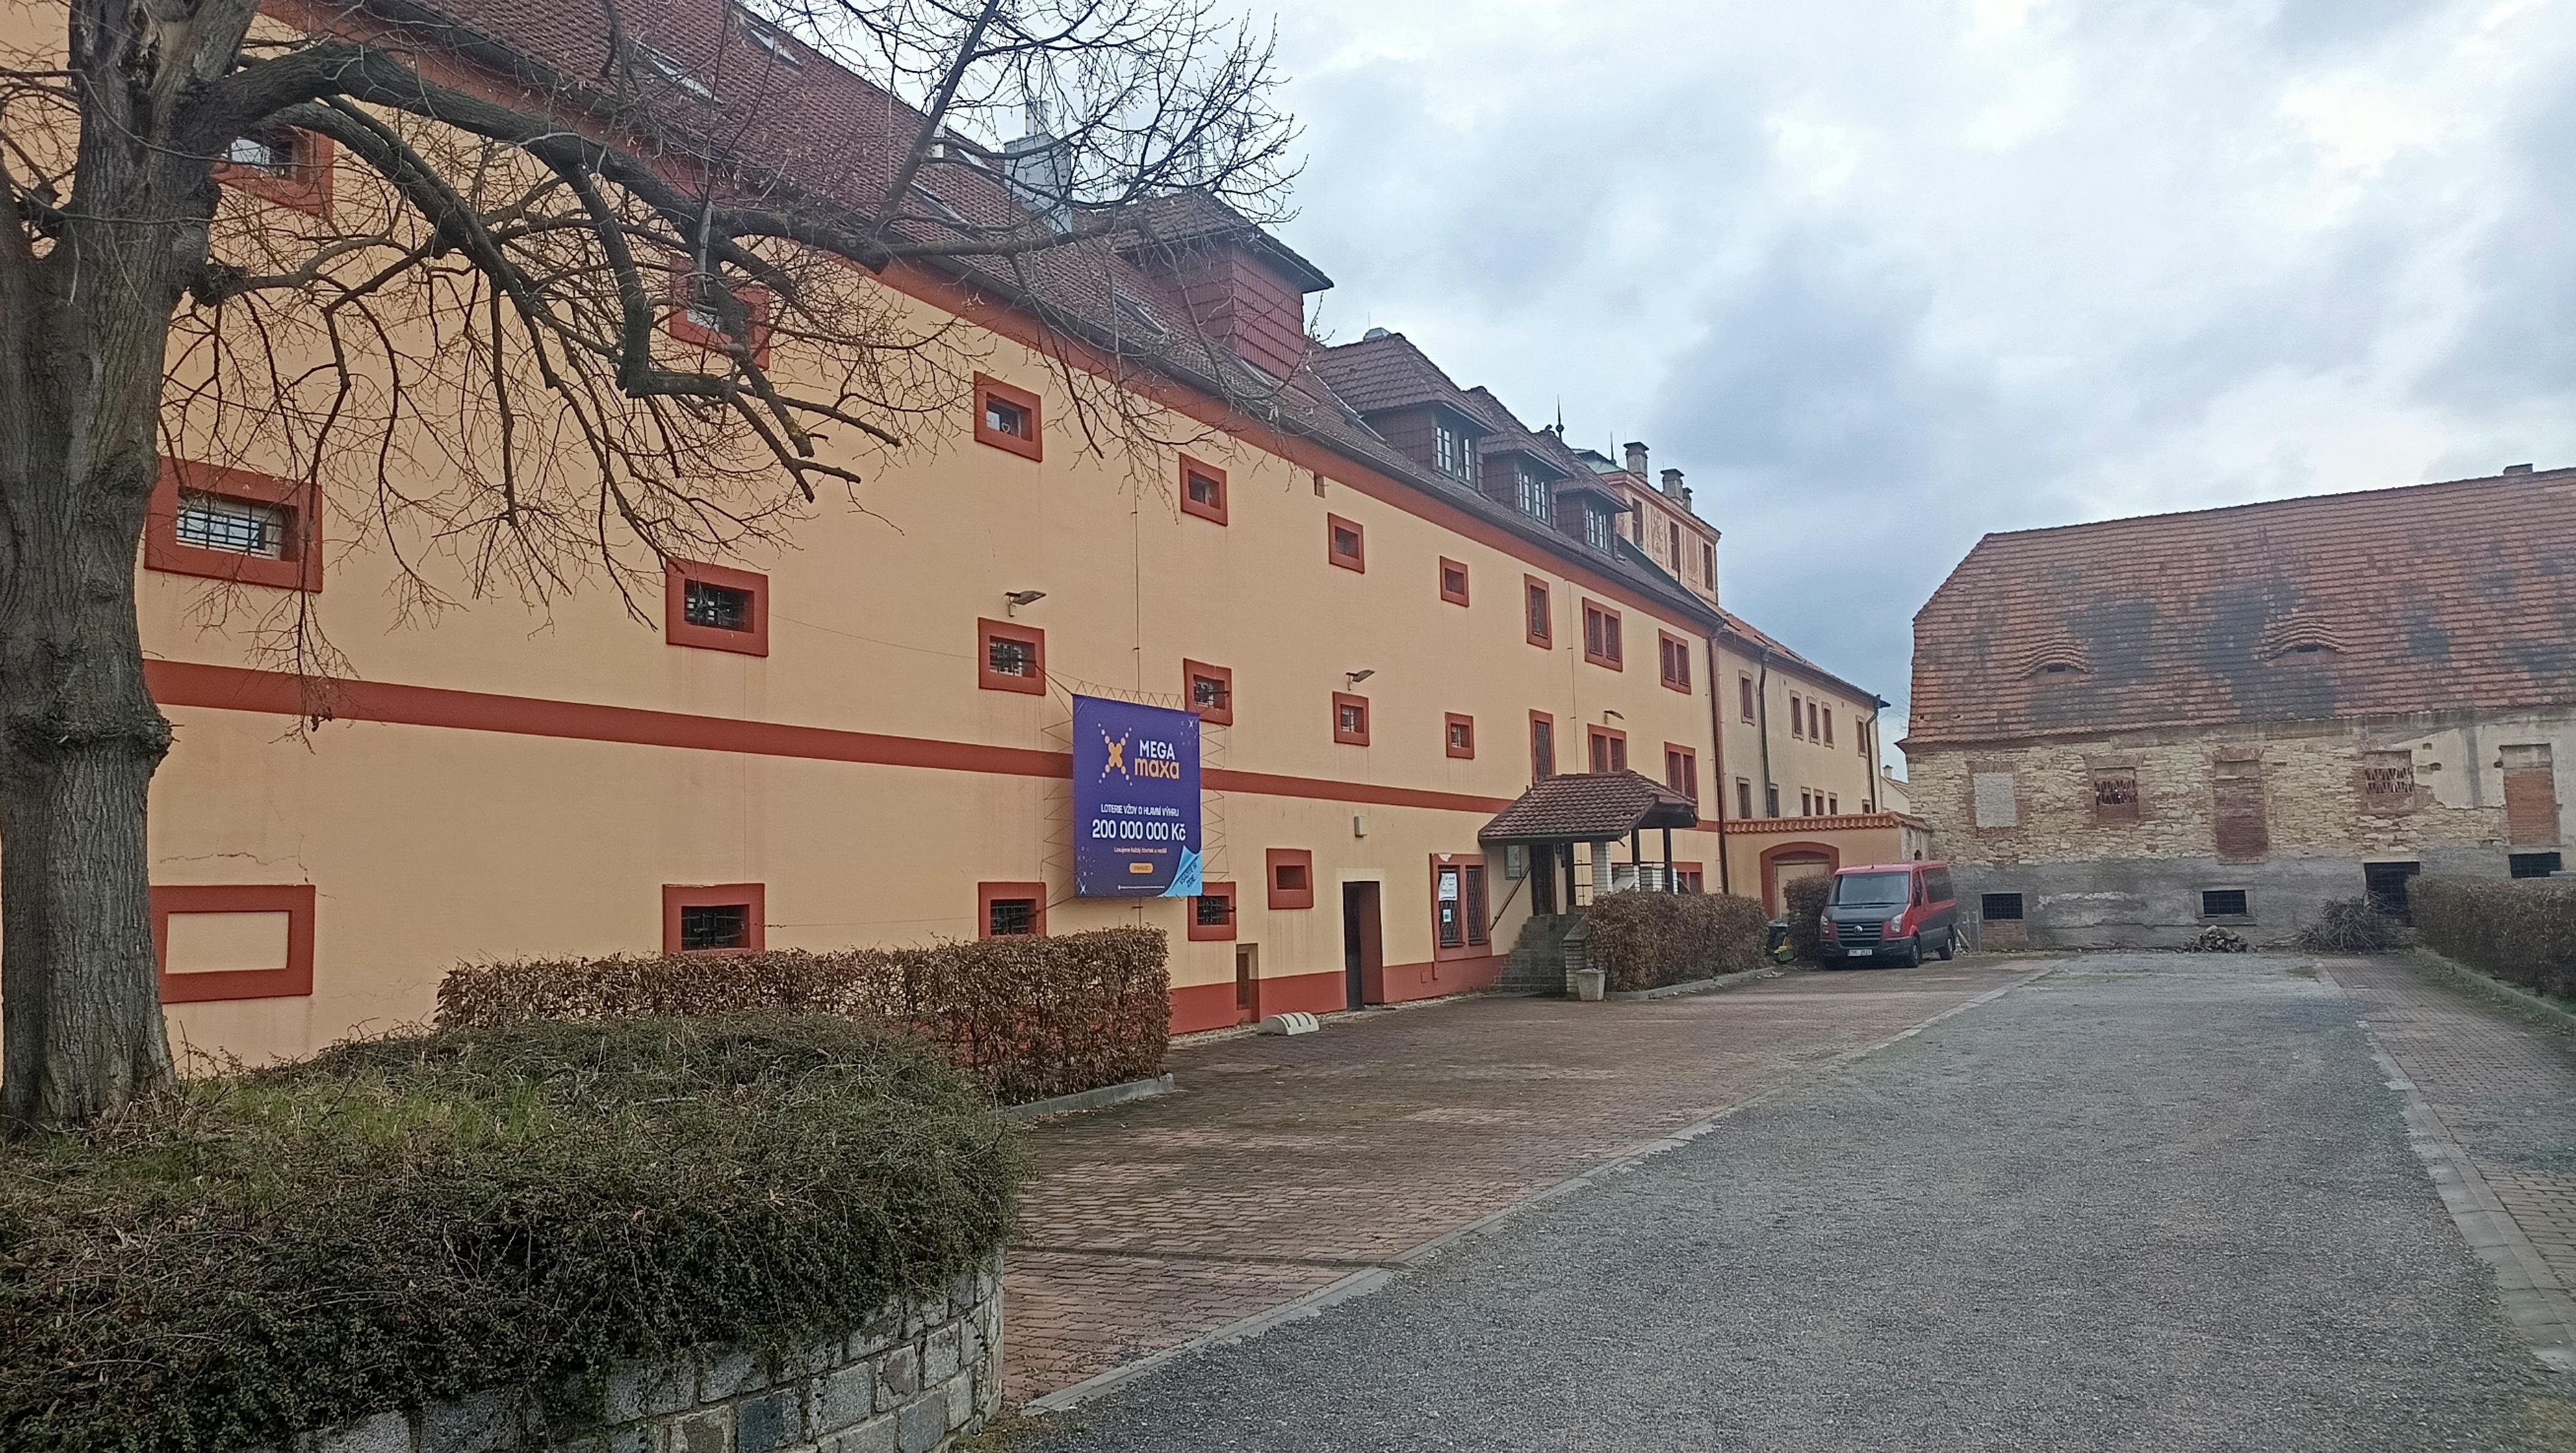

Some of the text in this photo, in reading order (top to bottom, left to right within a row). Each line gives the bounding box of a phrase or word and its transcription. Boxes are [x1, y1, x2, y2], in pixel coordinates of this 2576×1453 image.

[1139, 739, 1175, 760] MEGA
[1135, 757, 1180, 779] maxa
[1100, 803, 1123, 814] LOTERIE
[1123, 803, 1138, 815] VŽDY
[1138, 806, 1143, 815] O
[1092, 819, 1186, 841] 200 000 000 Kč
